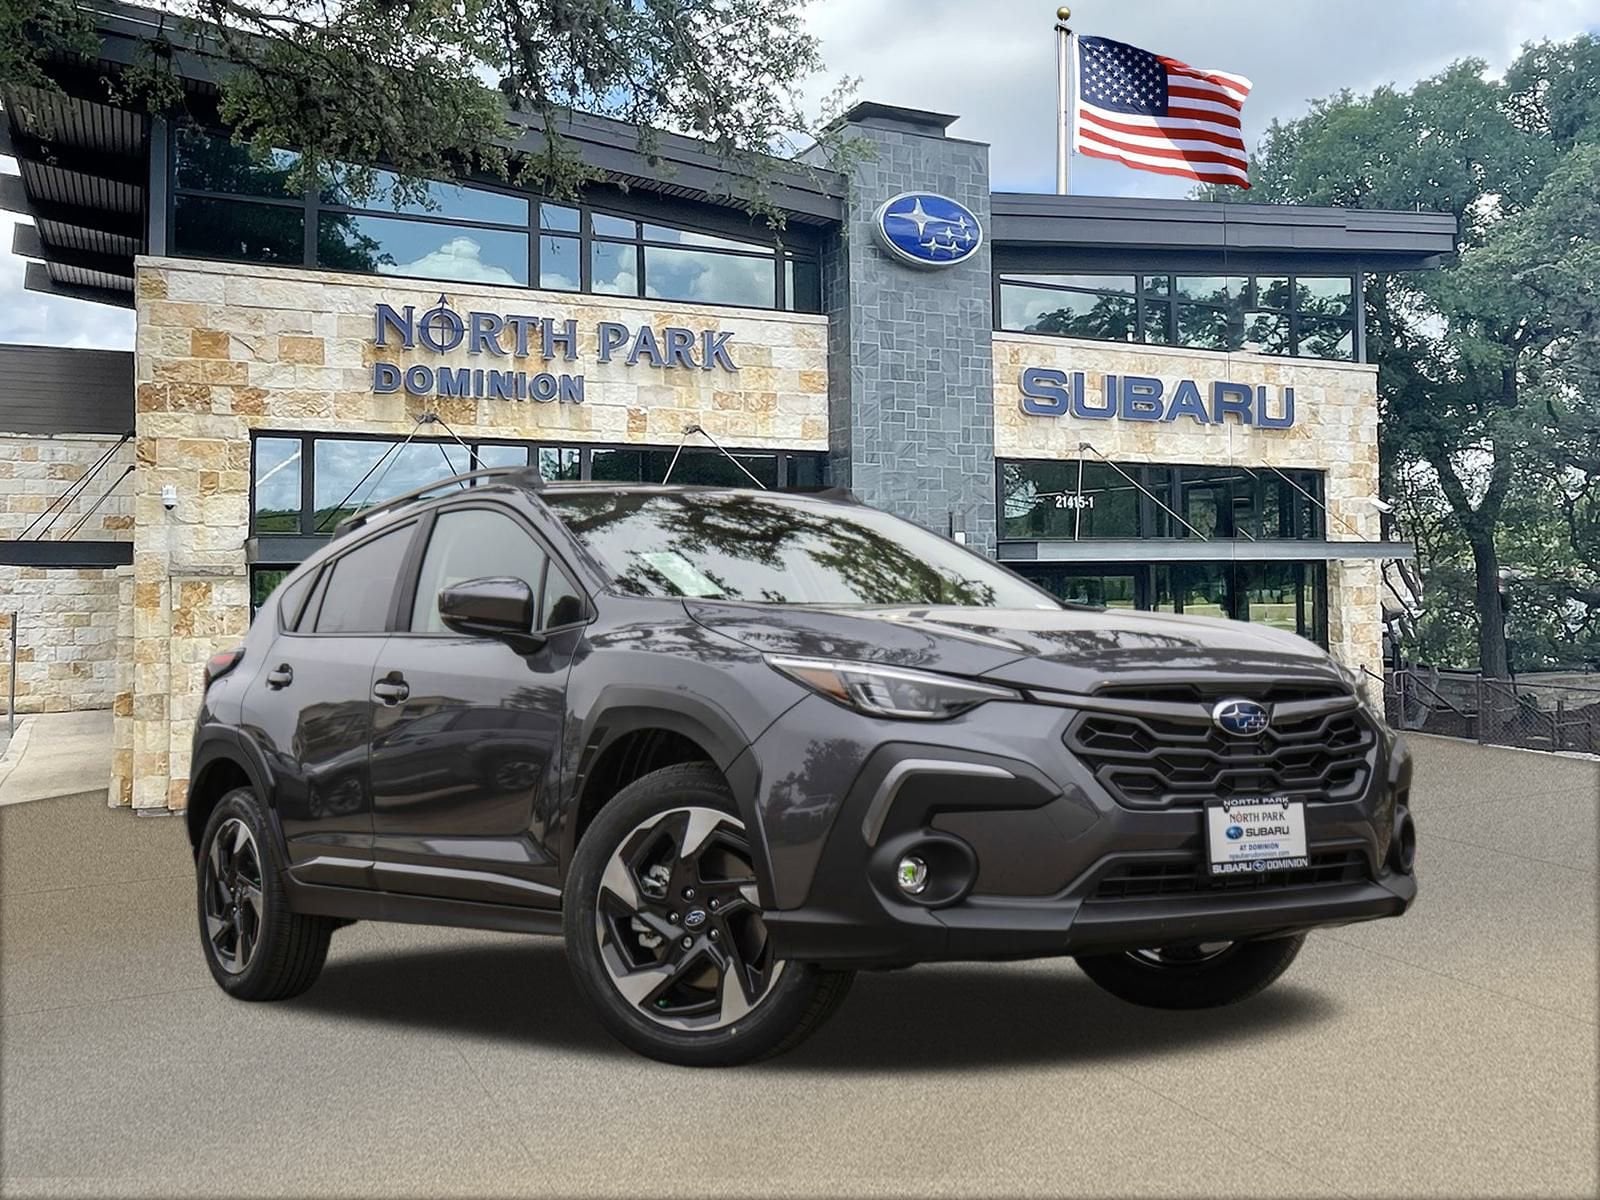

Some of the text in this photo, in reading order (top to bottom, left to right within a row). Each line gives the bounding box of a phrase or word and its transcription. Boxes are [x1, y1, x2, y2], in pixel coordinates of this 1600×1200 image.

[373, 294, 741, 373] NORTH PARK
[373, 361, 585, 405] DOMINION
[1018, 366, 1297, 430] SUBARU
[1055, 495, 1094, 509] 21415-1
[1223, 798, 1259, 806] NORTH
[1229, 811, 1286, 824] NORTH PARK
[1245, 826, 1290, 837] SUBARU
[1248, 842, 1280, 851] DOMINION
[1212, 858, 1308, 873] SUBARU DOMINION
